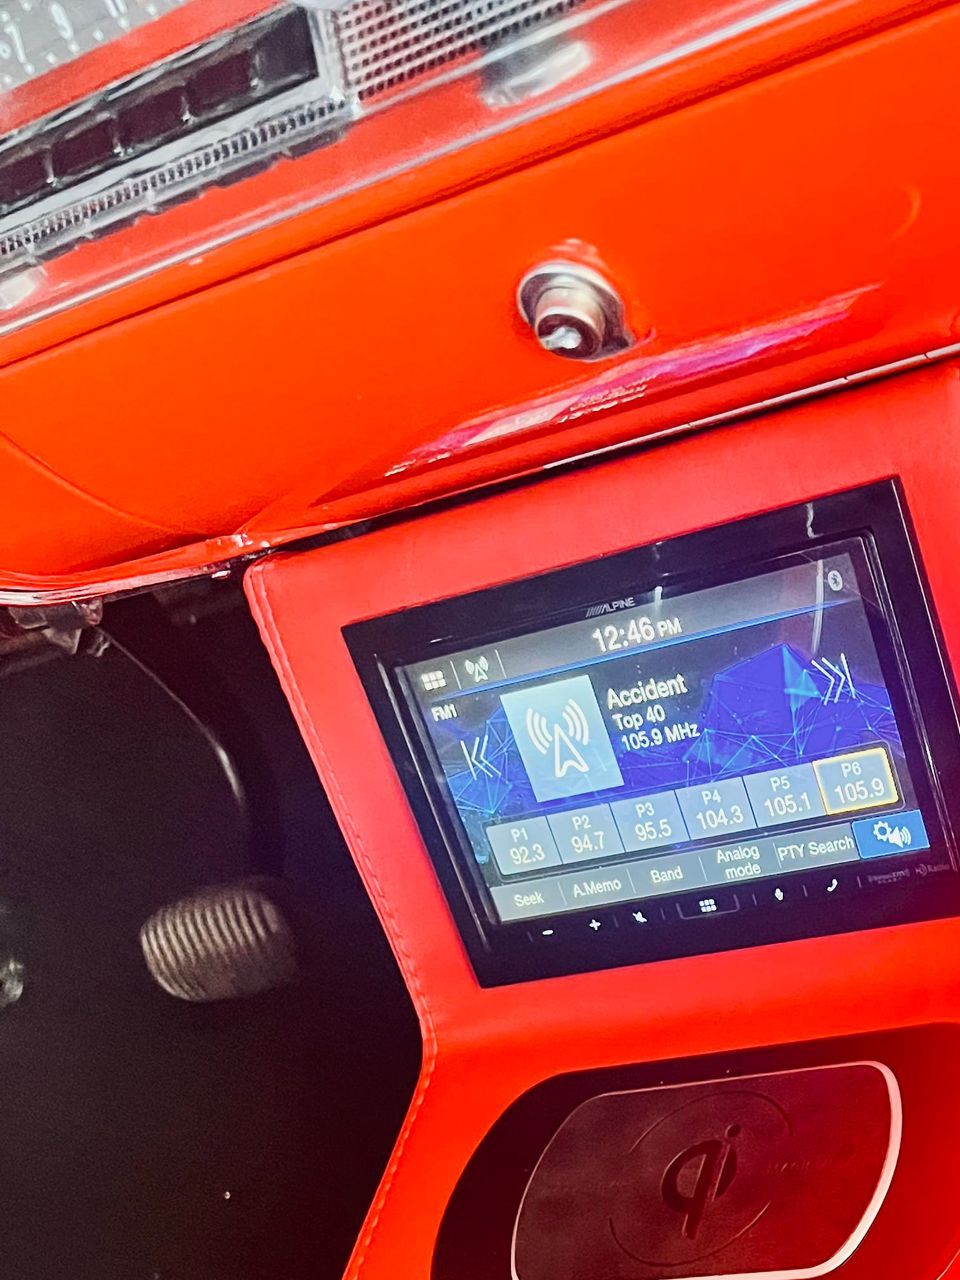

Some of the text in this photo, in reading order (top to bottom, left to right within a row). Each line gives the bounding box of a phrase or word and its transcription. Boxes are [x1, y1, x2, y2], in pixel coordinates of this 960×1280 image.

[592, 617, 683, 652] 12:46 PM
[607, 674, 688, 710] Accident
[431, 703, 458, 721] FM1
[612, 704, 666, 732] Top 40
[621, 722, 701, 752] 105.9 MHz
[841, 761, 862, 778] P6
[769, 776, 791, 792] P5
[834, 778, 886, 804] 105.9
[701, 789, 721, 805] P4
[763, 792, 812, 817] 105.1
[635, 802, 655, 818] P3
[696, 805, 745, 830] 104.3
[572, 814, 591, 830] P2
[634, 818, 672, 842] 95.5
[510, 827, 528, 842] P1
[570, 831, 605, 854] 94.7
[509, 843, 545, 865] 92.3
[716, 845, 761, 866] Analog
[777, 835, 855, 862] PTY Search
[650, 866, 684, 884] Band
[725, 862, 762, 880] mode
[573, 877, 622, 898] A.Memo
[513, 890, 544, 908] Seek
